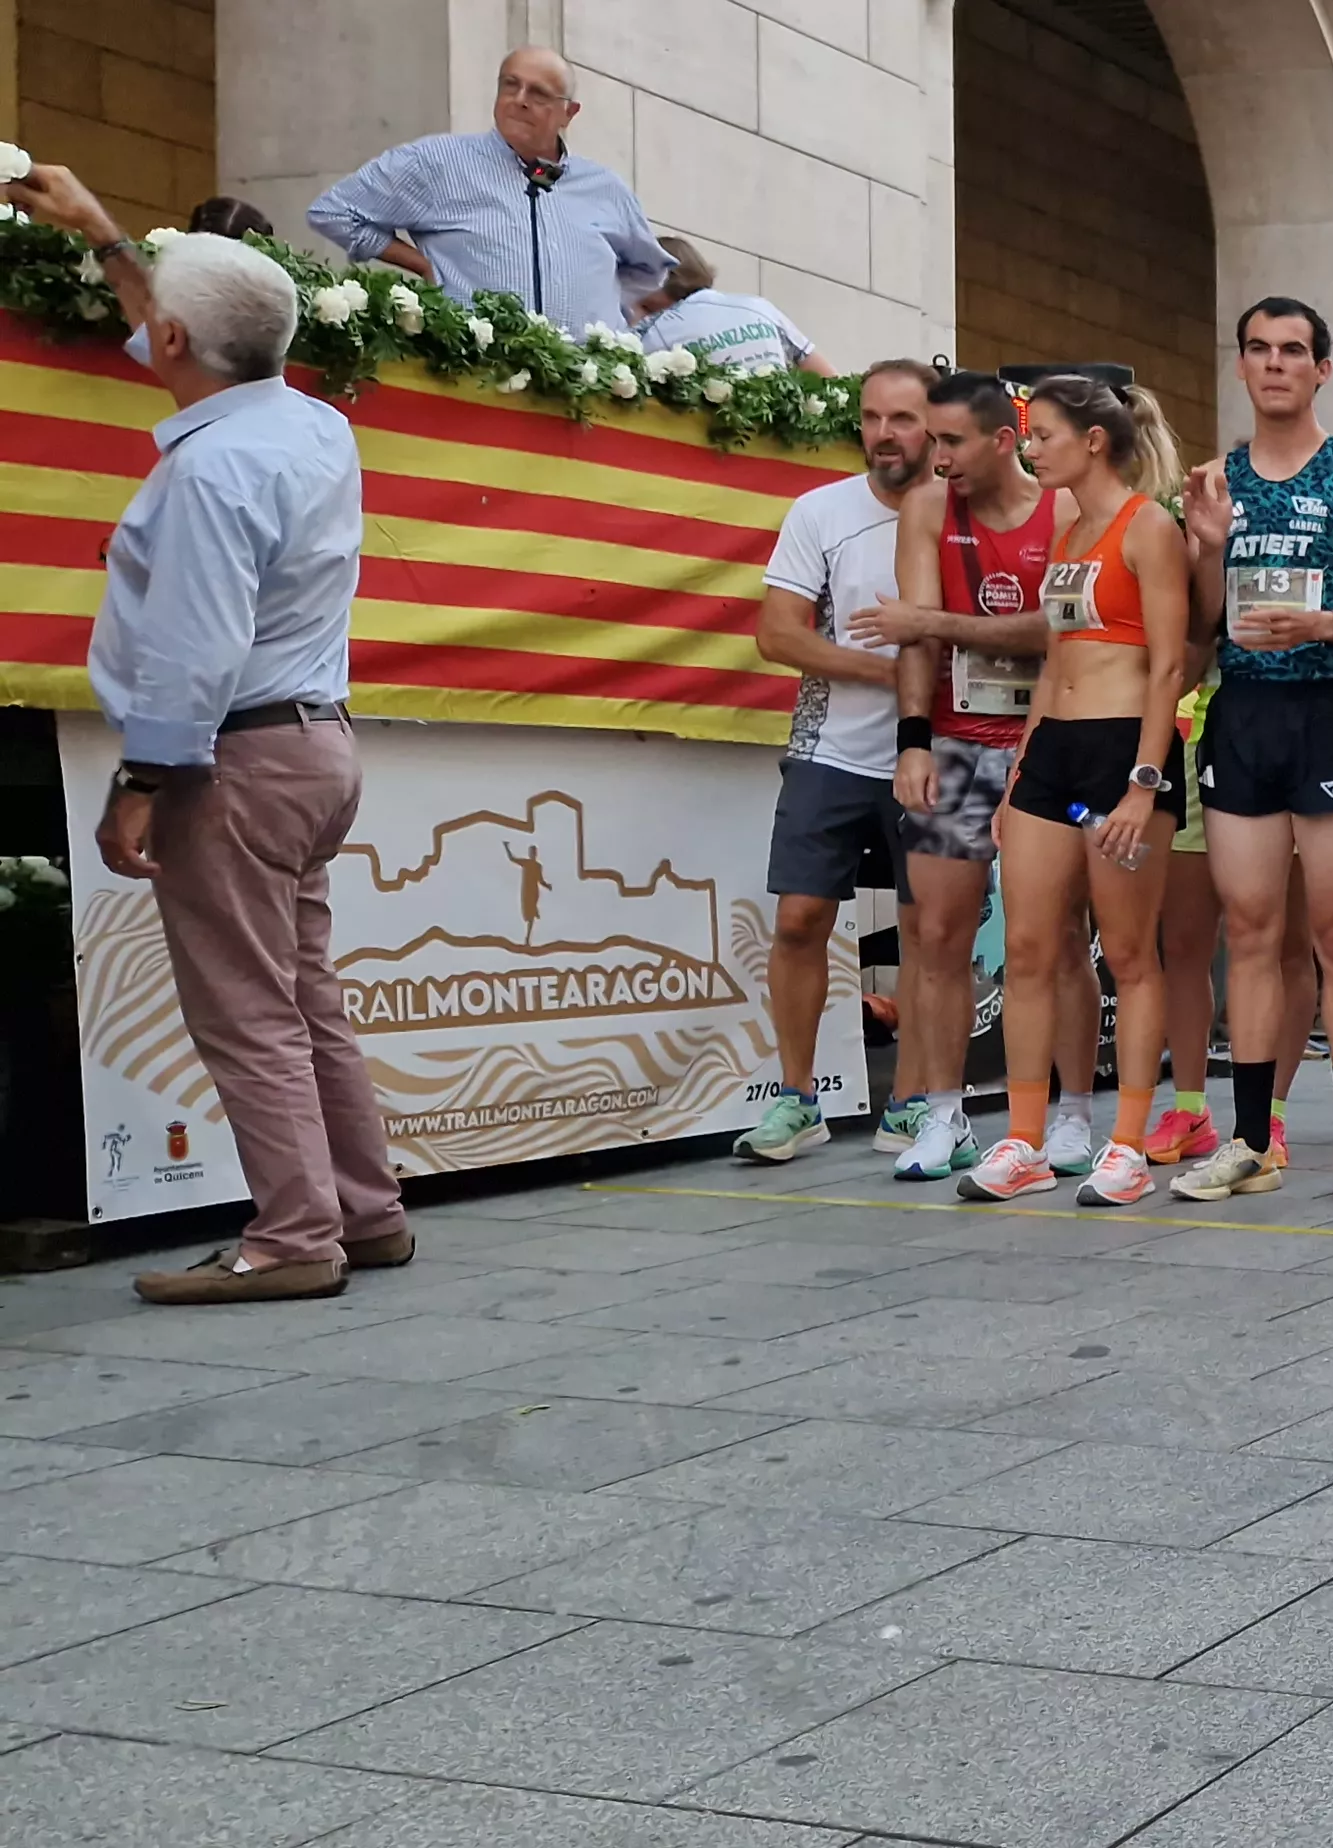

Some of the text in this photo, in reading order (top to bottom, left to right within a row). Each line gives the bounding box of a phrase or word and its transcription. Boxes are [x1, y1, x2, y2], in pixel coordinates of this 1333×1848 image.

[1054, 563, 1081, 586] 27
[1252, 569, 1291, 593] 13
[387, 1088, 660, 1137] WWW.TRAILMONTEARAGON.COM
